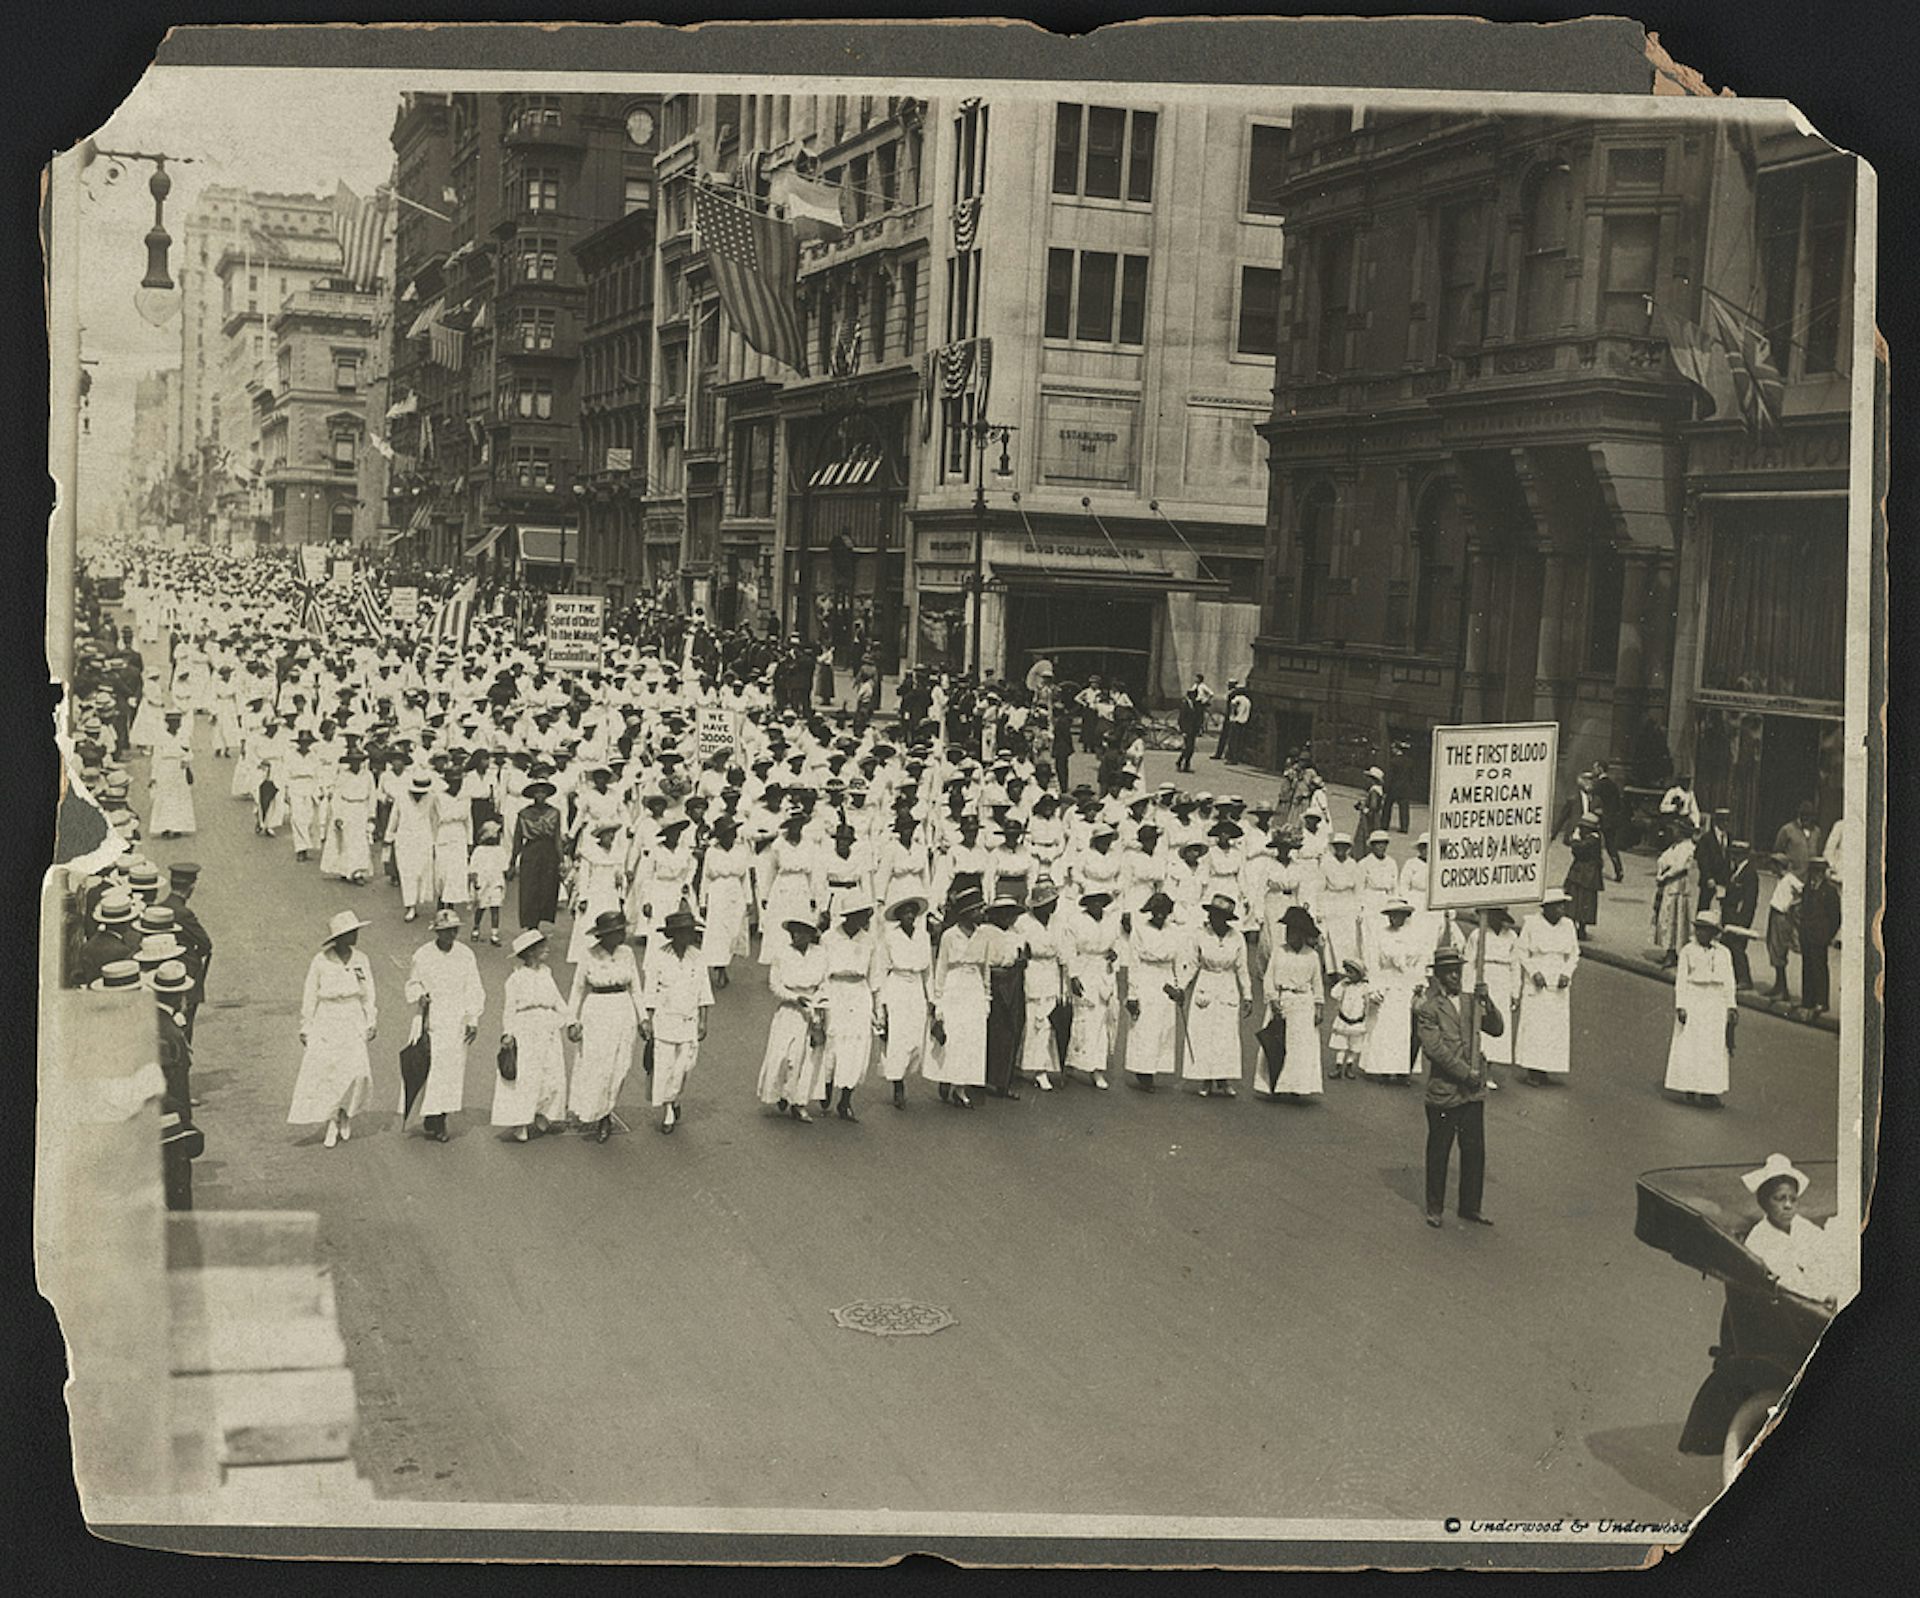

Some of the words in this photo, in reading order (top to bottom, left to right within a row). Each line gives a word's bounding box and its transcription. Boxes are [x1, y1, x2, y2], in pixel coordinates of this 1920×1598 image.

[555, 603, 575, 613] PUT
[579, 604, 595, 614] THE
[702, 723, 728, 732] HAVE
[708, 713, 724, 722] WE
[1446, 745, 1473, 765] THE
[1476, 743, 1509, 764] FIRST
[1511, 742, 1547, 762] BLOOD
[1476, 768, 1512, 780] FOR
[1449, 784, 1532, 804] AMERICAN
[1440, 806, 1543, 829] INDEPENDENCE
[1438, 838, 1459, 860] Was
[1461, 836, 1484, 859] Shed
[1487, 836, 1498, 861] By
[1500, 835, 1508, 857] A
[1509, 833, 1542, 859] Negro
[1441, 866, 1490, 888] CRISPUS
[1491, 863, 1537, 885] ATTUCKS
